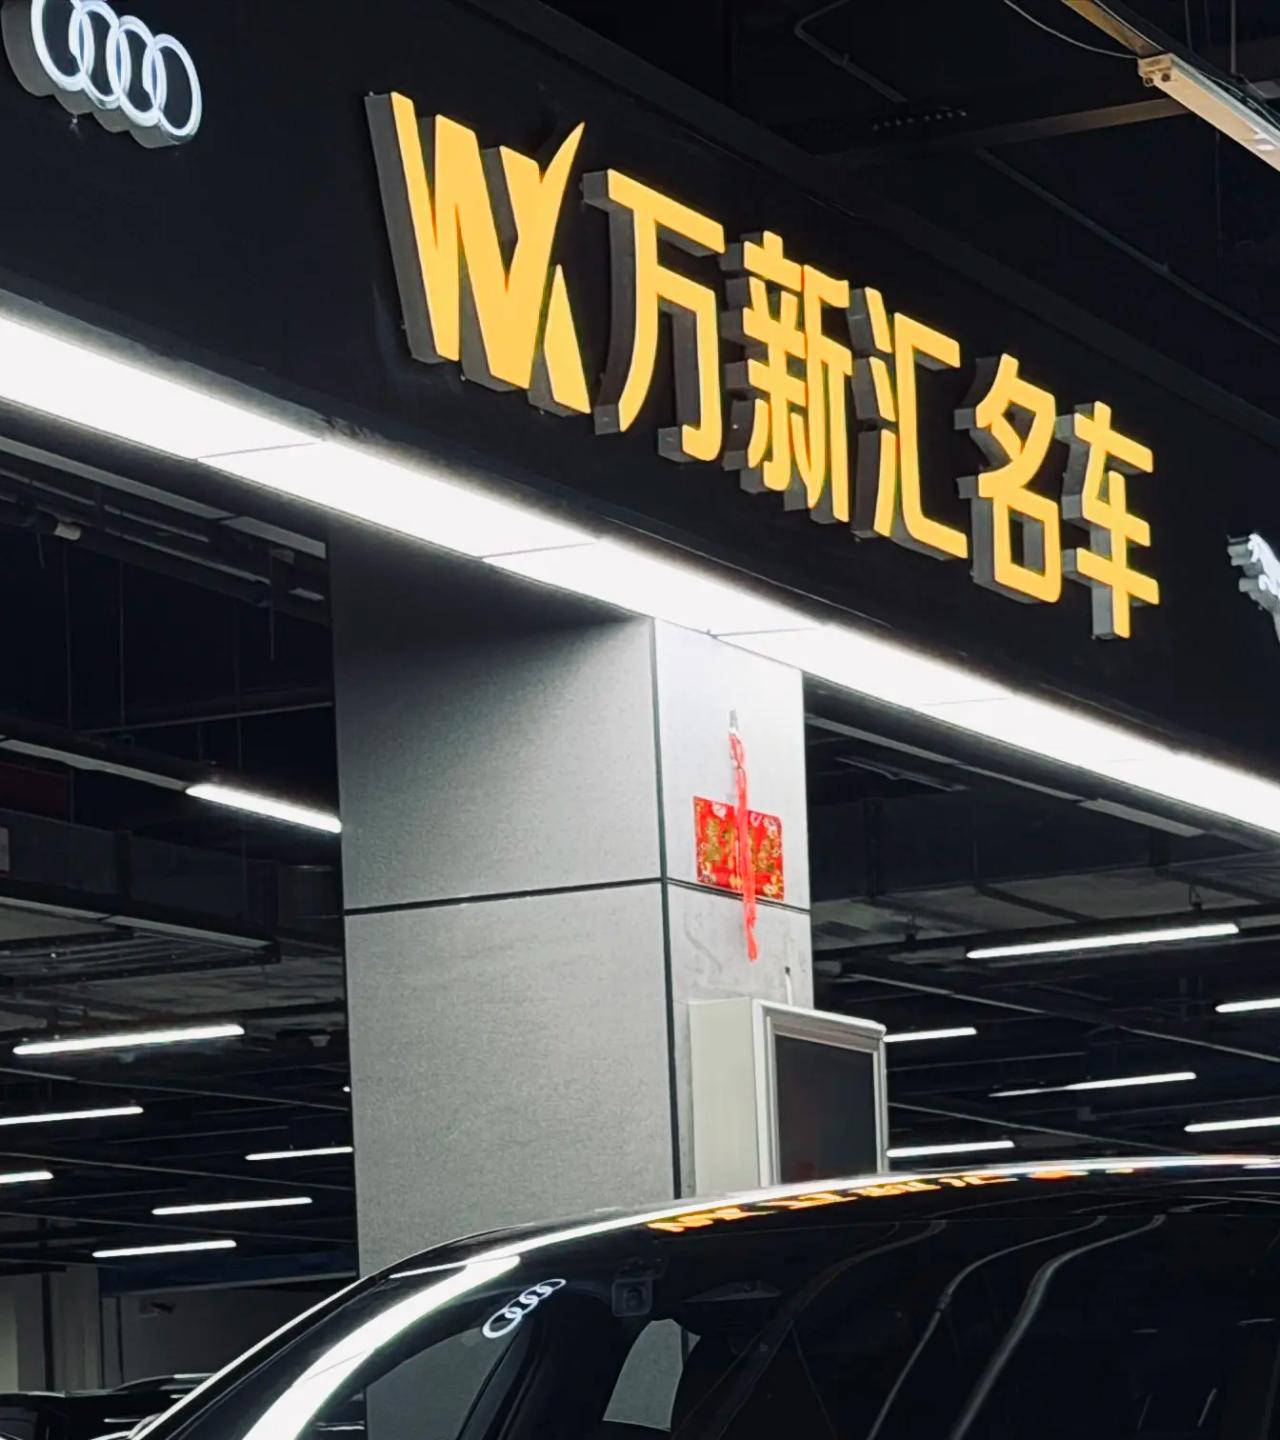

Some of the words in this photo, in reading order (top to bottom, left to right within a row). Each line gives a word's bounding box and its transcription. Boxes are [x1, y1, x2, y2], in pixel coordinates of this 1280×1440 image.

[606, 167, 1160, 638] 万新汇名车
